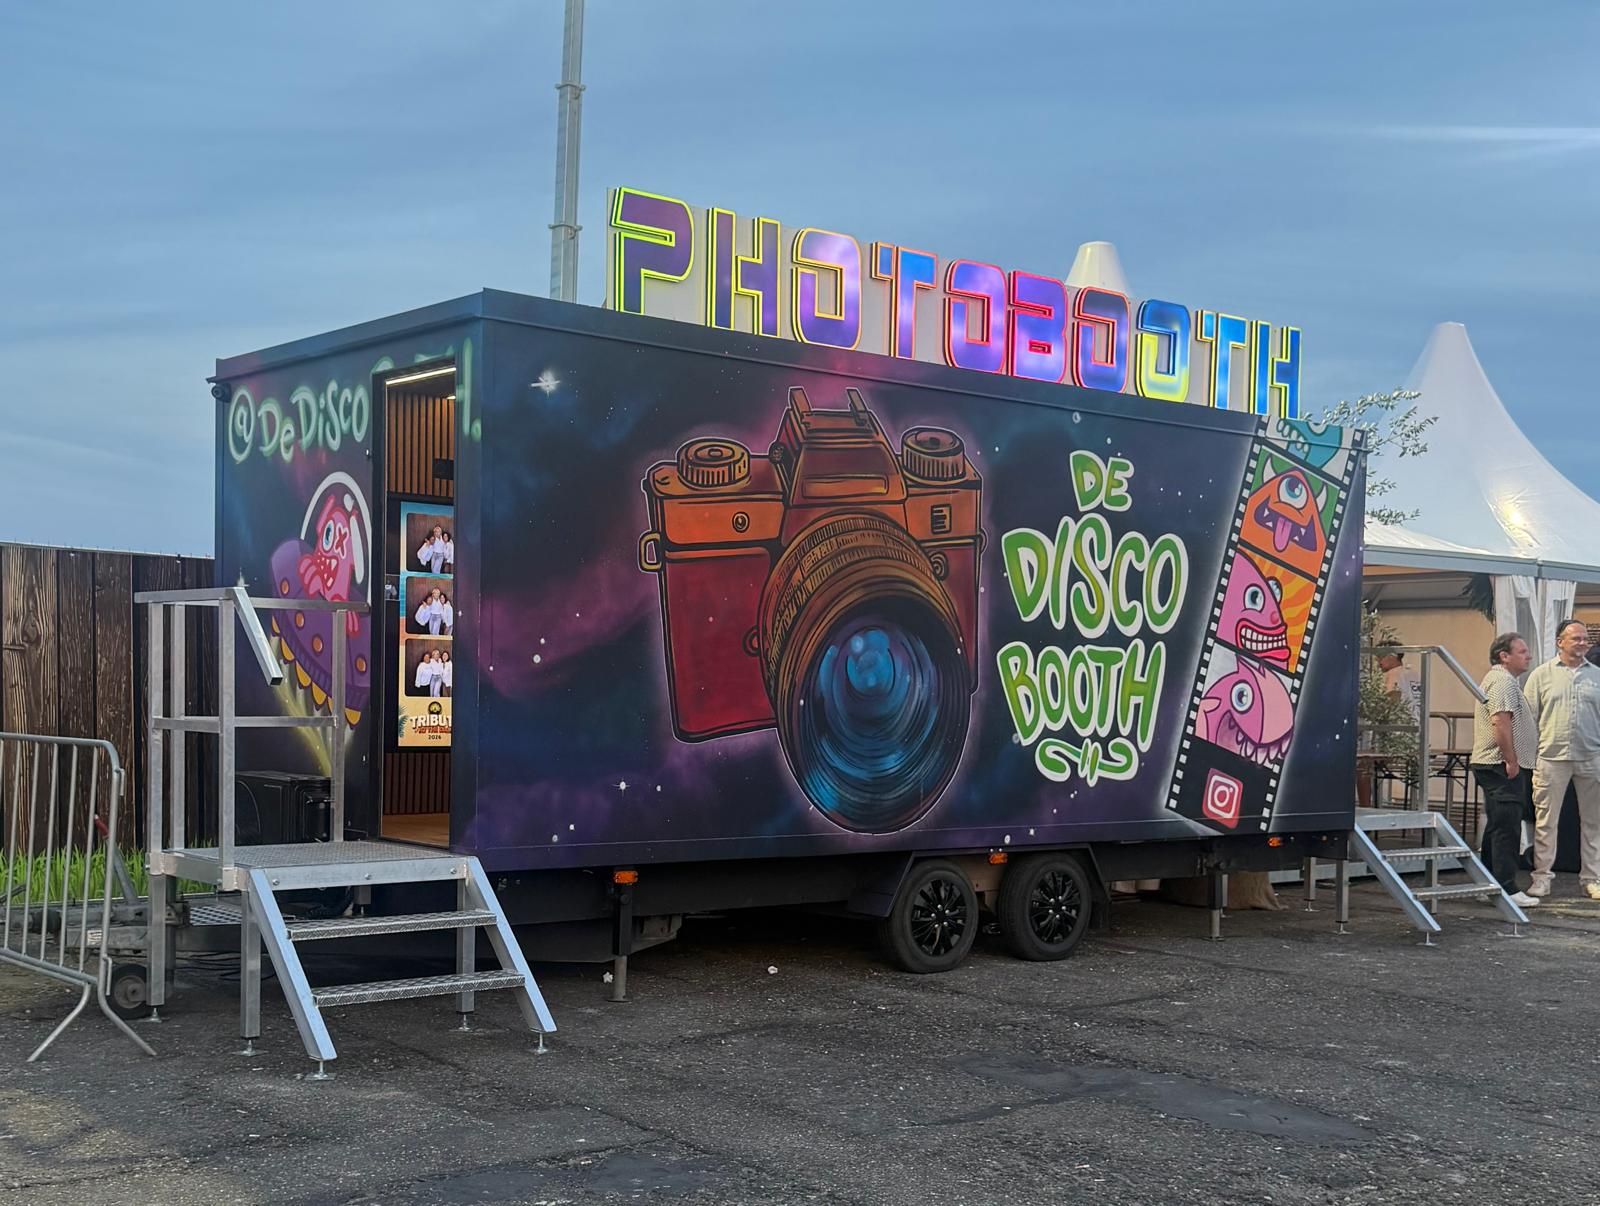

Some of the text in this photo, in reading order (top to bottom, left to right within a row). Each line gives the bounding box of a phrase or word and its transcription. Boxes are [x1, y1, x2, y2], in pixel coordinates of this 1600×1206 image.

[611, 187, 1302, 420] PHOTOBOOTH
[1069, 450, 1135, 512] DE
[1002, 513, 1188, 638] DISCO
[997, 638, 1165, 752] BOOTH
